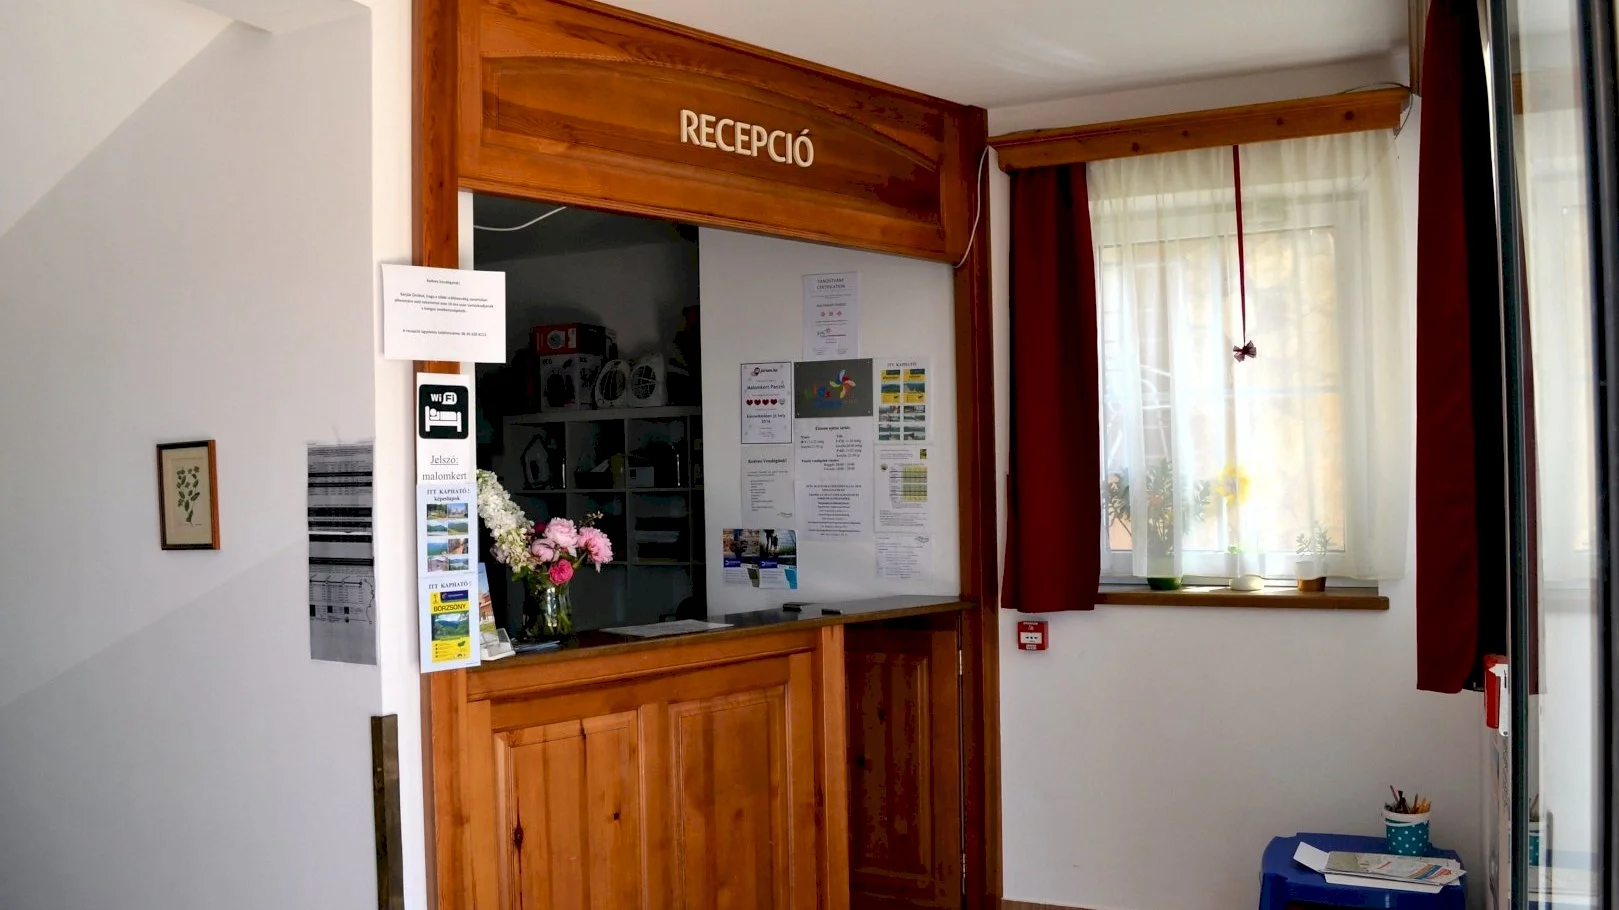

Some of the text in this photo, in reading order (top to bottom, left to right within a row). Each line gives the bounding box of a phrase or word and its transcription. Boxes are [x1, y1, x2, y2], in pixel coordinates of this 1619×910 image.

[680, 109, 814, 168] RECEPCIÓ
[430, 455, 459, 465] Jelszó:
[422, 471, 467, 481] malomkert
